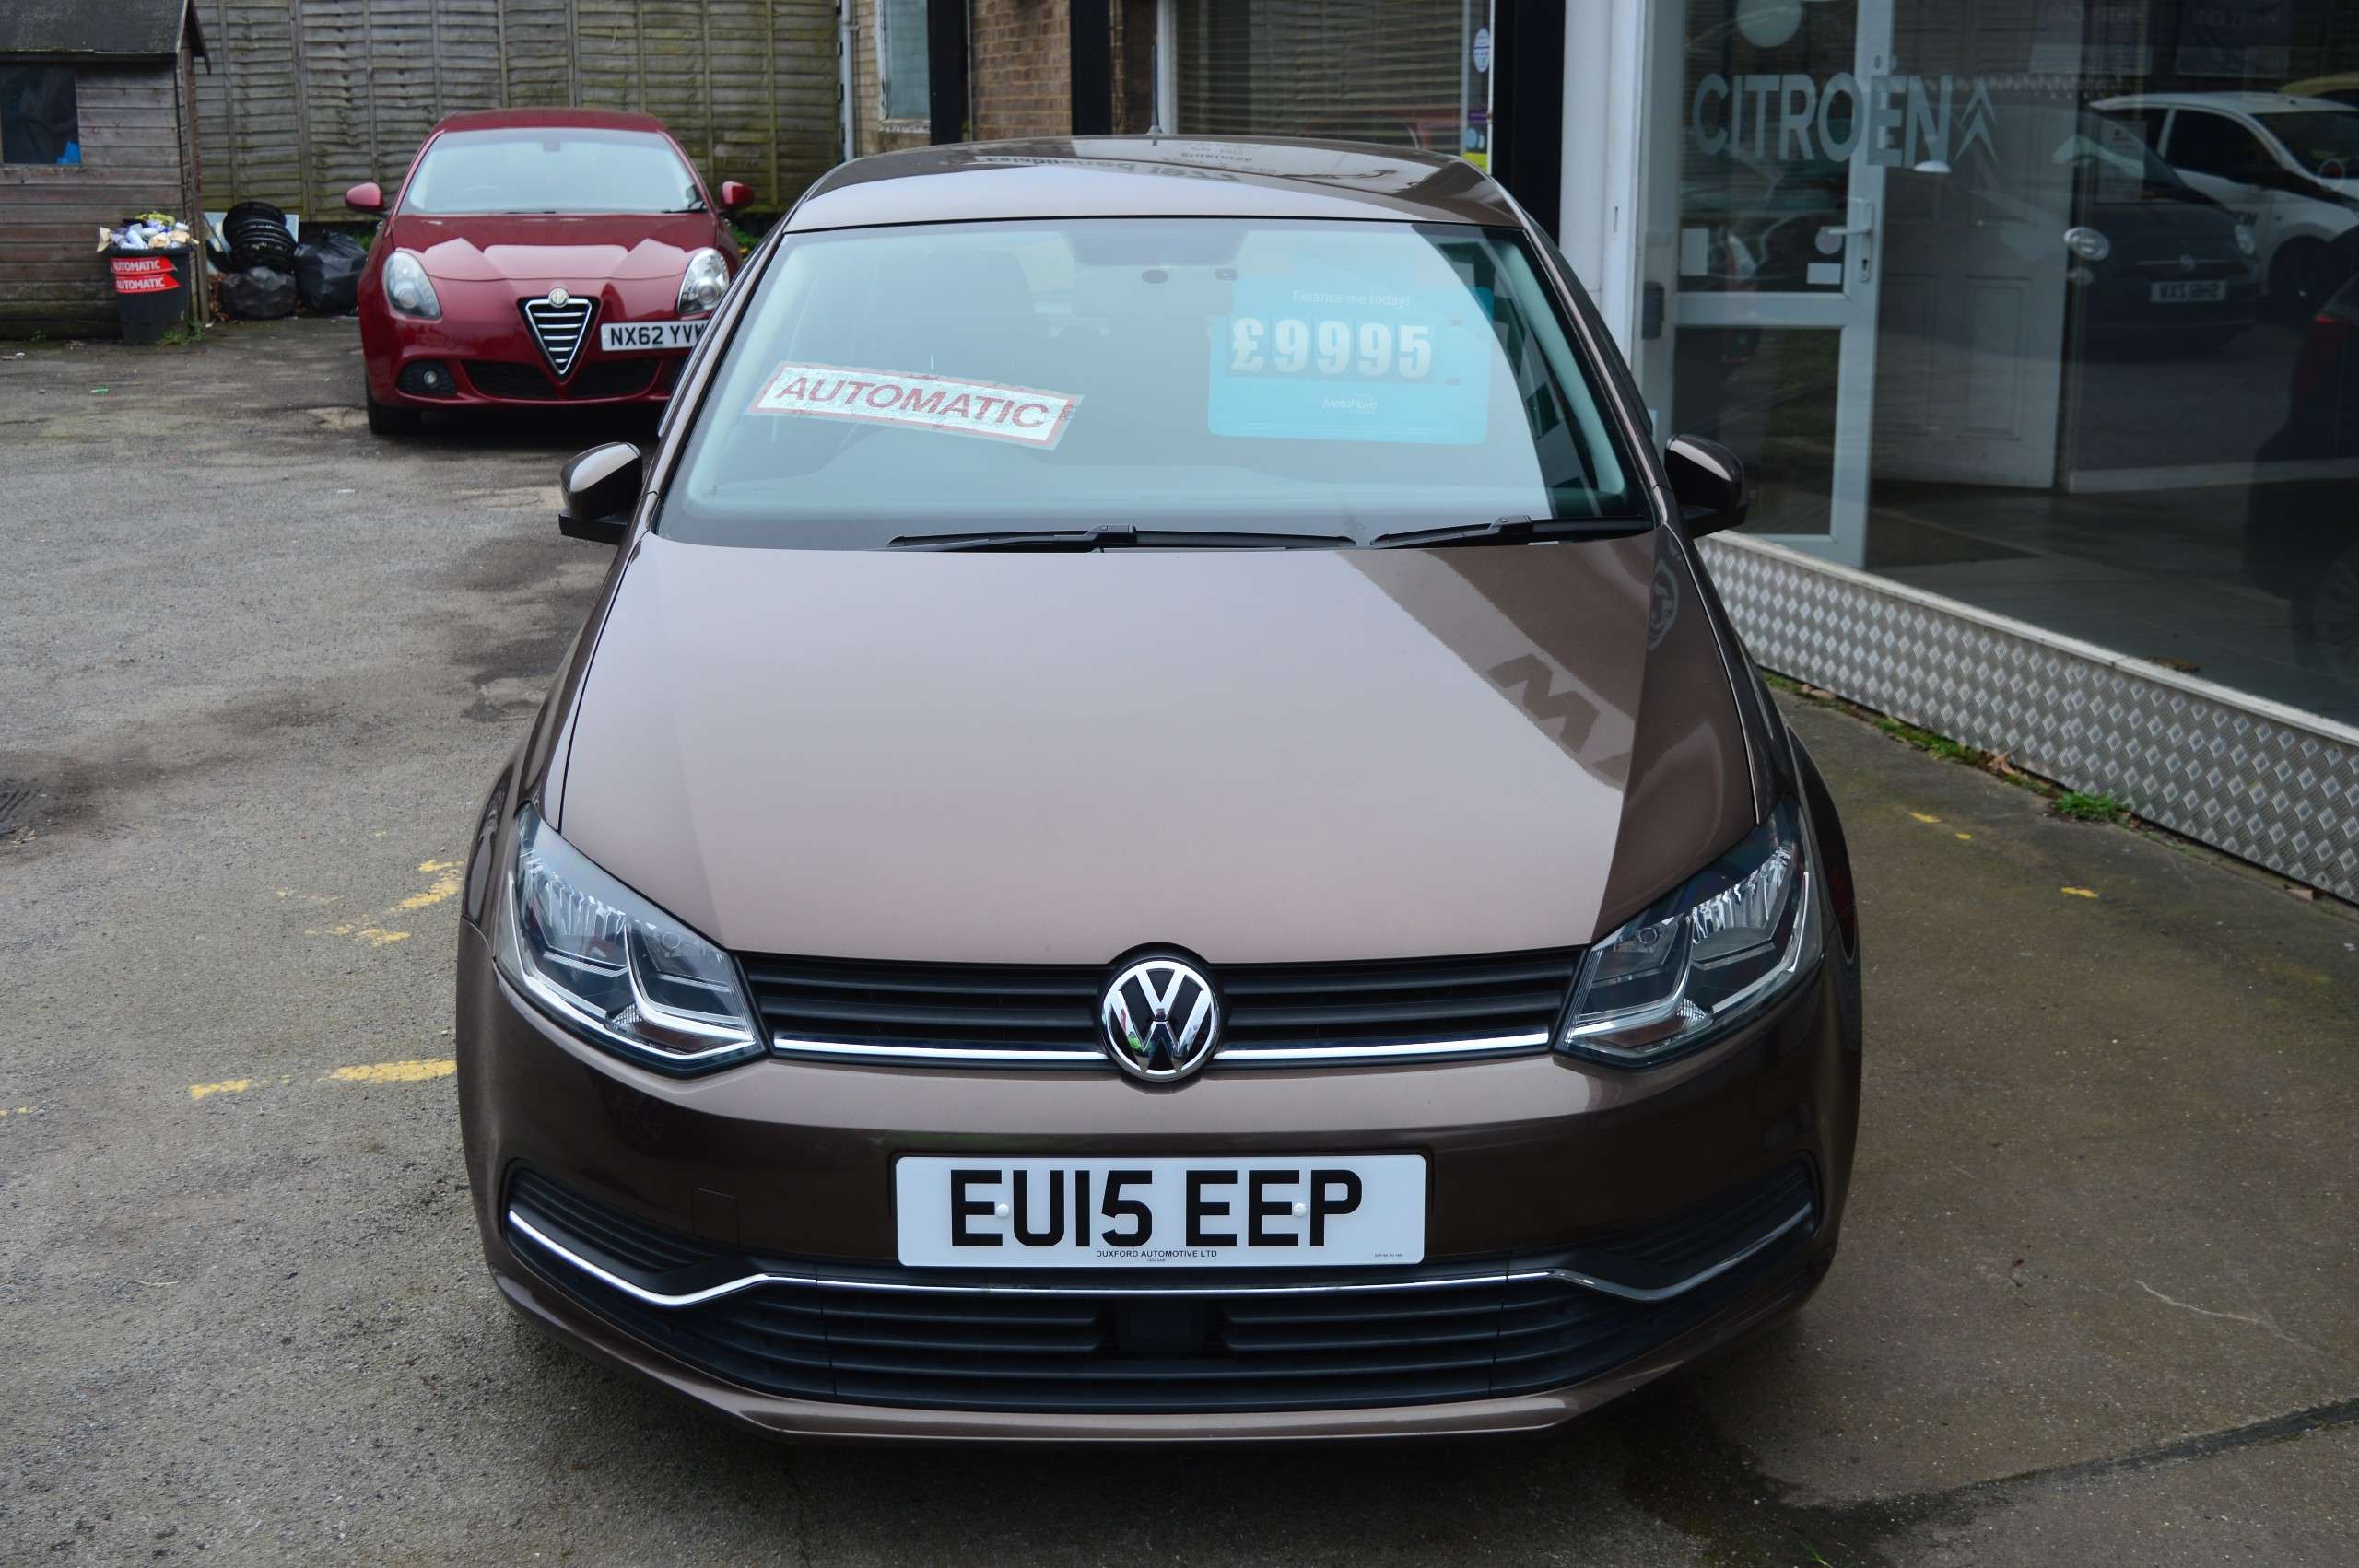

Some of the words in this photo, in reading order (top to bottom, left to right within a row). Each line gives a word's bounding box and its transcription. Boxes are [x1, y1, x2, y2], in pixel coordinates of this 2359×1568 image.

[1292, 289, 1344, 304] Finance
[1345, 294, 1367, 304] me
[1369, 294, 1411, 309] today!
[610, 326, 664, 345] NX62
[1230, 318, 1432, 379] £9995
[776, 377, 1050, 428] AUTOMATIC
[950, 1169, 1153, 1247] EU15
[1185, 1169, 1363, 1247] EEP
[1096, 1249, 1139, 1258] DUXFORD
[1141, 1249, 1198, 1258] AUTOMOTIVE
[1200, 1249, 1217, 1258] LTD
